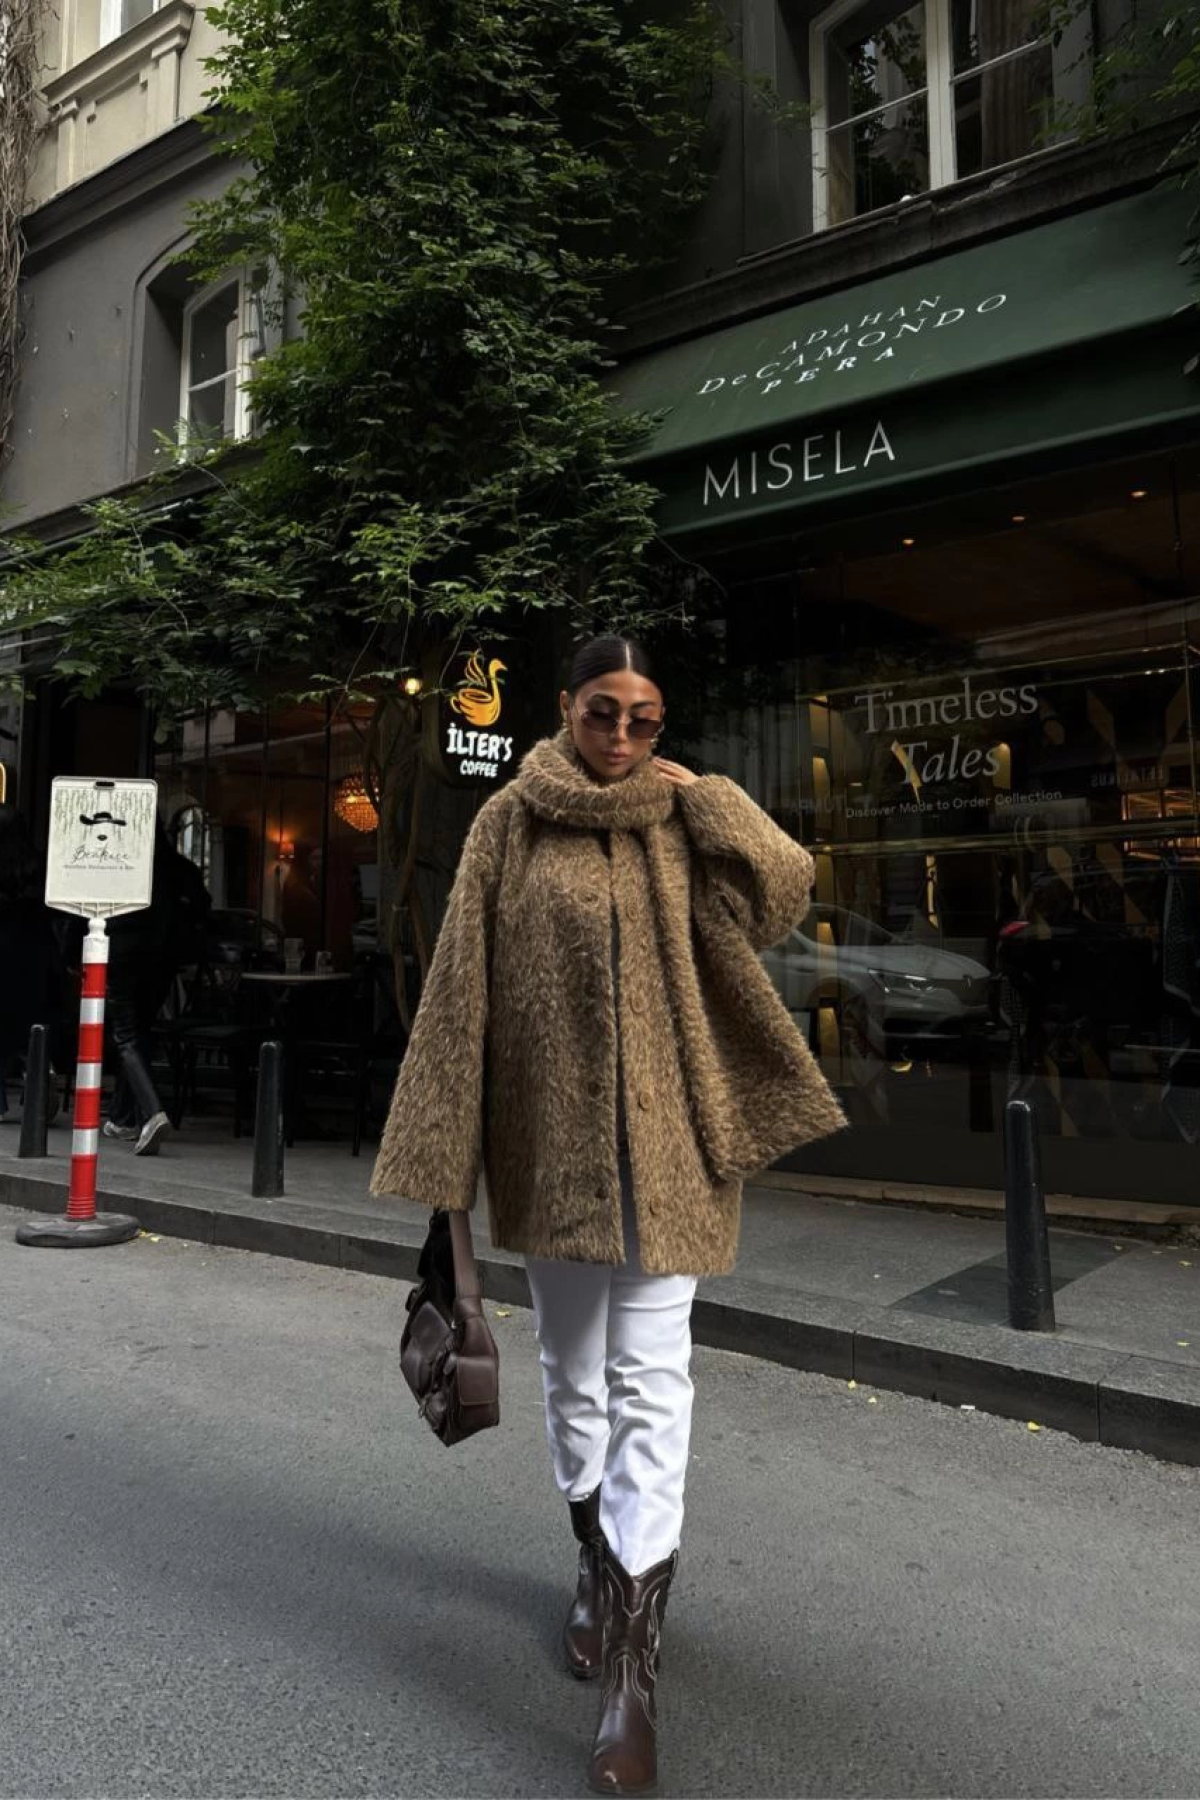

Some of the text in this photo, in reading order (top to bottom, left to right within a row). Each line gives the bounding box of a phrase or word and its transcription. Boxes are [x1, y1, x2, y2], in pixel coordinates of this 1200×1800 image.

[782, 295, 941, 353] ADAHAN
[761, 347, 894, 394] PERA
[703, 420, 895, 505] MISELA
[855, 676, 1038, 734] Timeless
[446, 722, 513, 762] İLTER'S
[900, 734, 1000, 785] Tales
[460, 760, 498, 777] COFFEE
[846, 807, 895, 818] Discover
[936, 800, 950, 811] to
[953, 796, 989, 809] Order
[995, 790, 1062, 805] Collection
